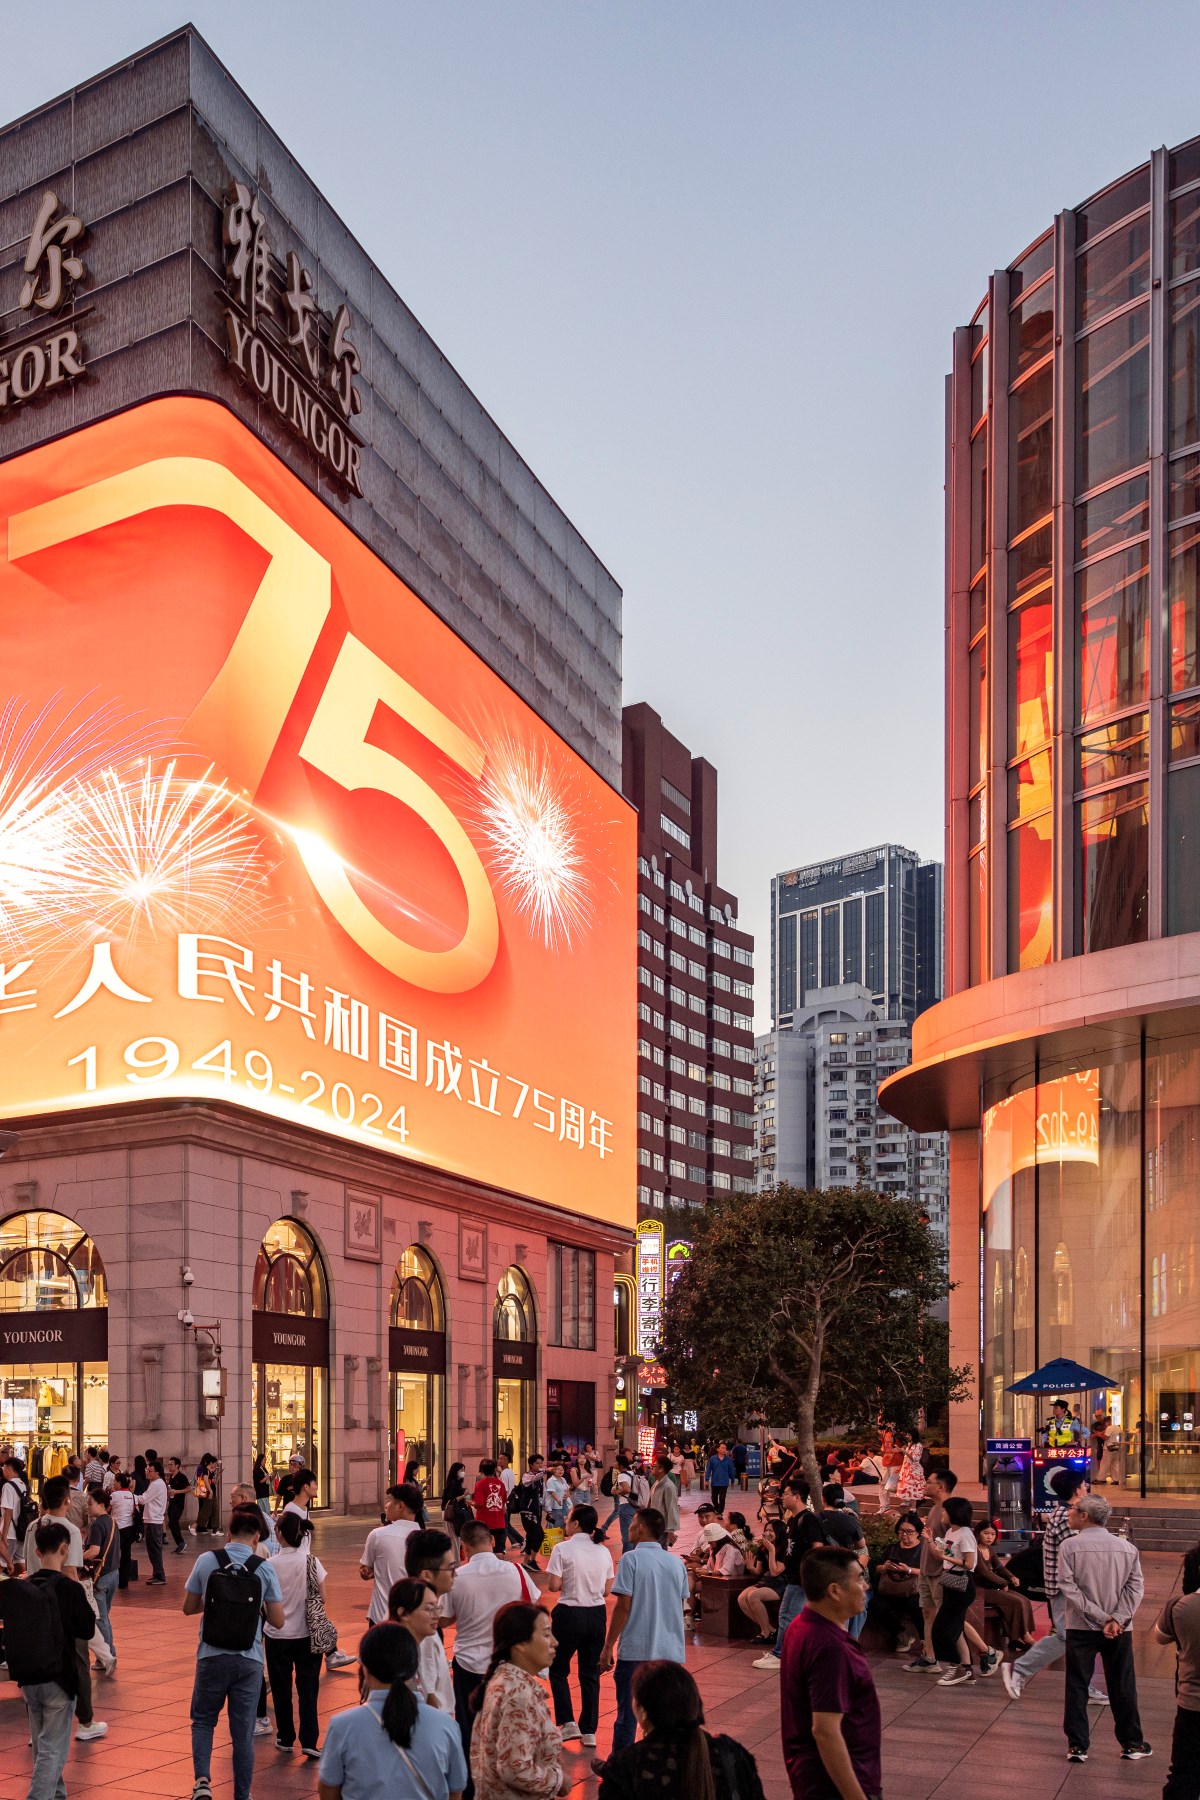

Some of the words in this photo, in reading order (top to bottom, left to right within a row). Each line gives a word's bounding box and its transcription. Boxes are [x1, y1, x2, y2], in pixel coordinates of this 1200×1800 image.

[225, 181, 362, 418] 雅戈尔
[227, 308, 364, 498] YOUNGOR
[8, 456, 500, 994] 75
[67, 1036, 410, 1143] 1949-2024
[4, 1330, 63, 1344] YOUNGOR
[272, 1332, 306, 1346] YOUNGOR
[403, 1344, 429, 1357] YOUNGOR
[641, 1278, 659, 1351] 行李寄存
